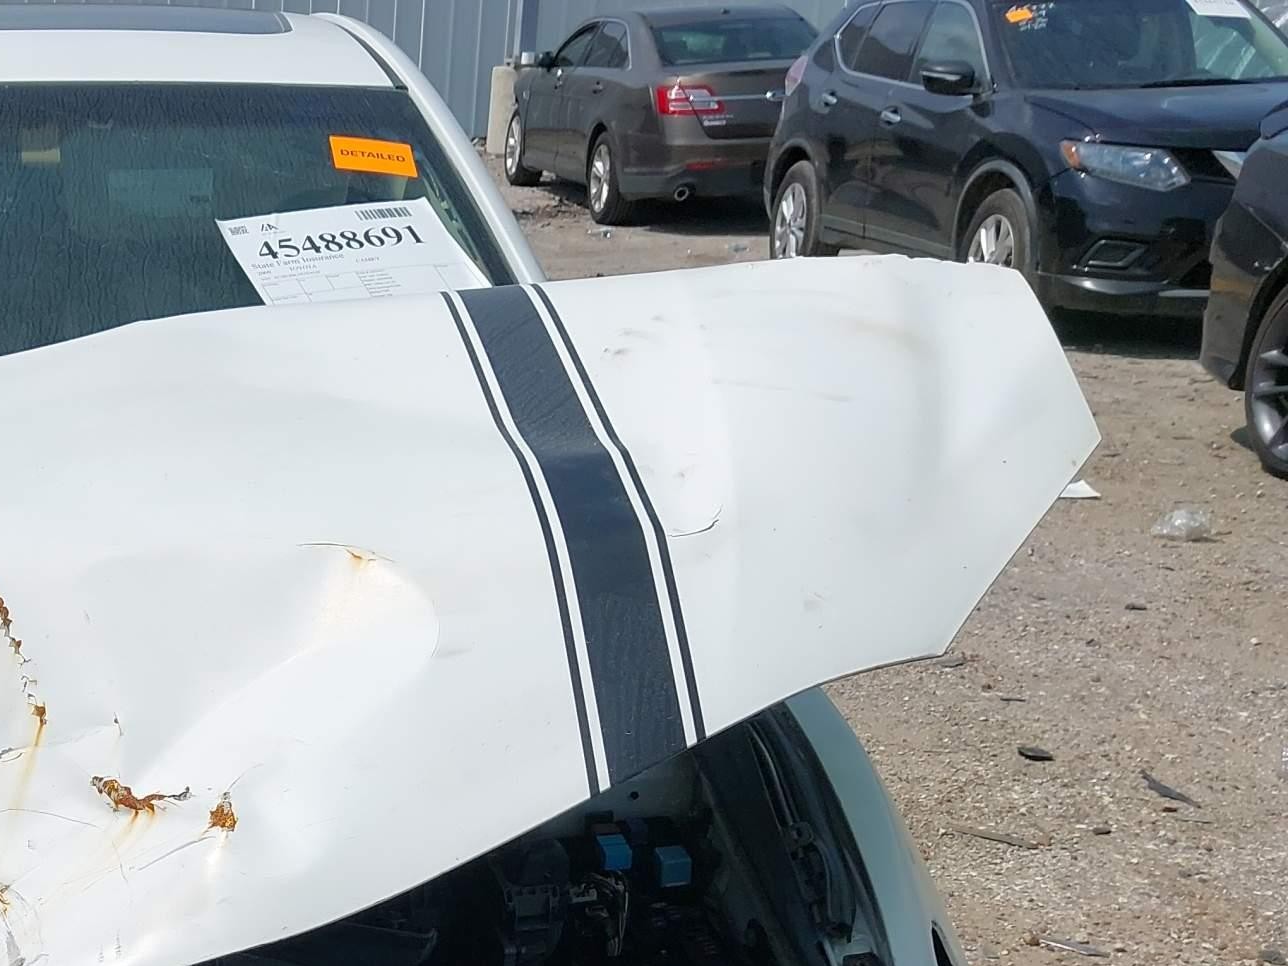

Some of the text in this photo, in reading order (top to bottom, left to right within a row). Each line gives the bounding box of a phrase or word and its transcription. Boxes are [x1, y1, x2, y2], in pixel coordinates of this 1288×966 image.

[340, 148, 406, 162] DETAILED
[258, 225, 425, 260] 45488691
[251, 252, 345, 270] State Farm Insurance
